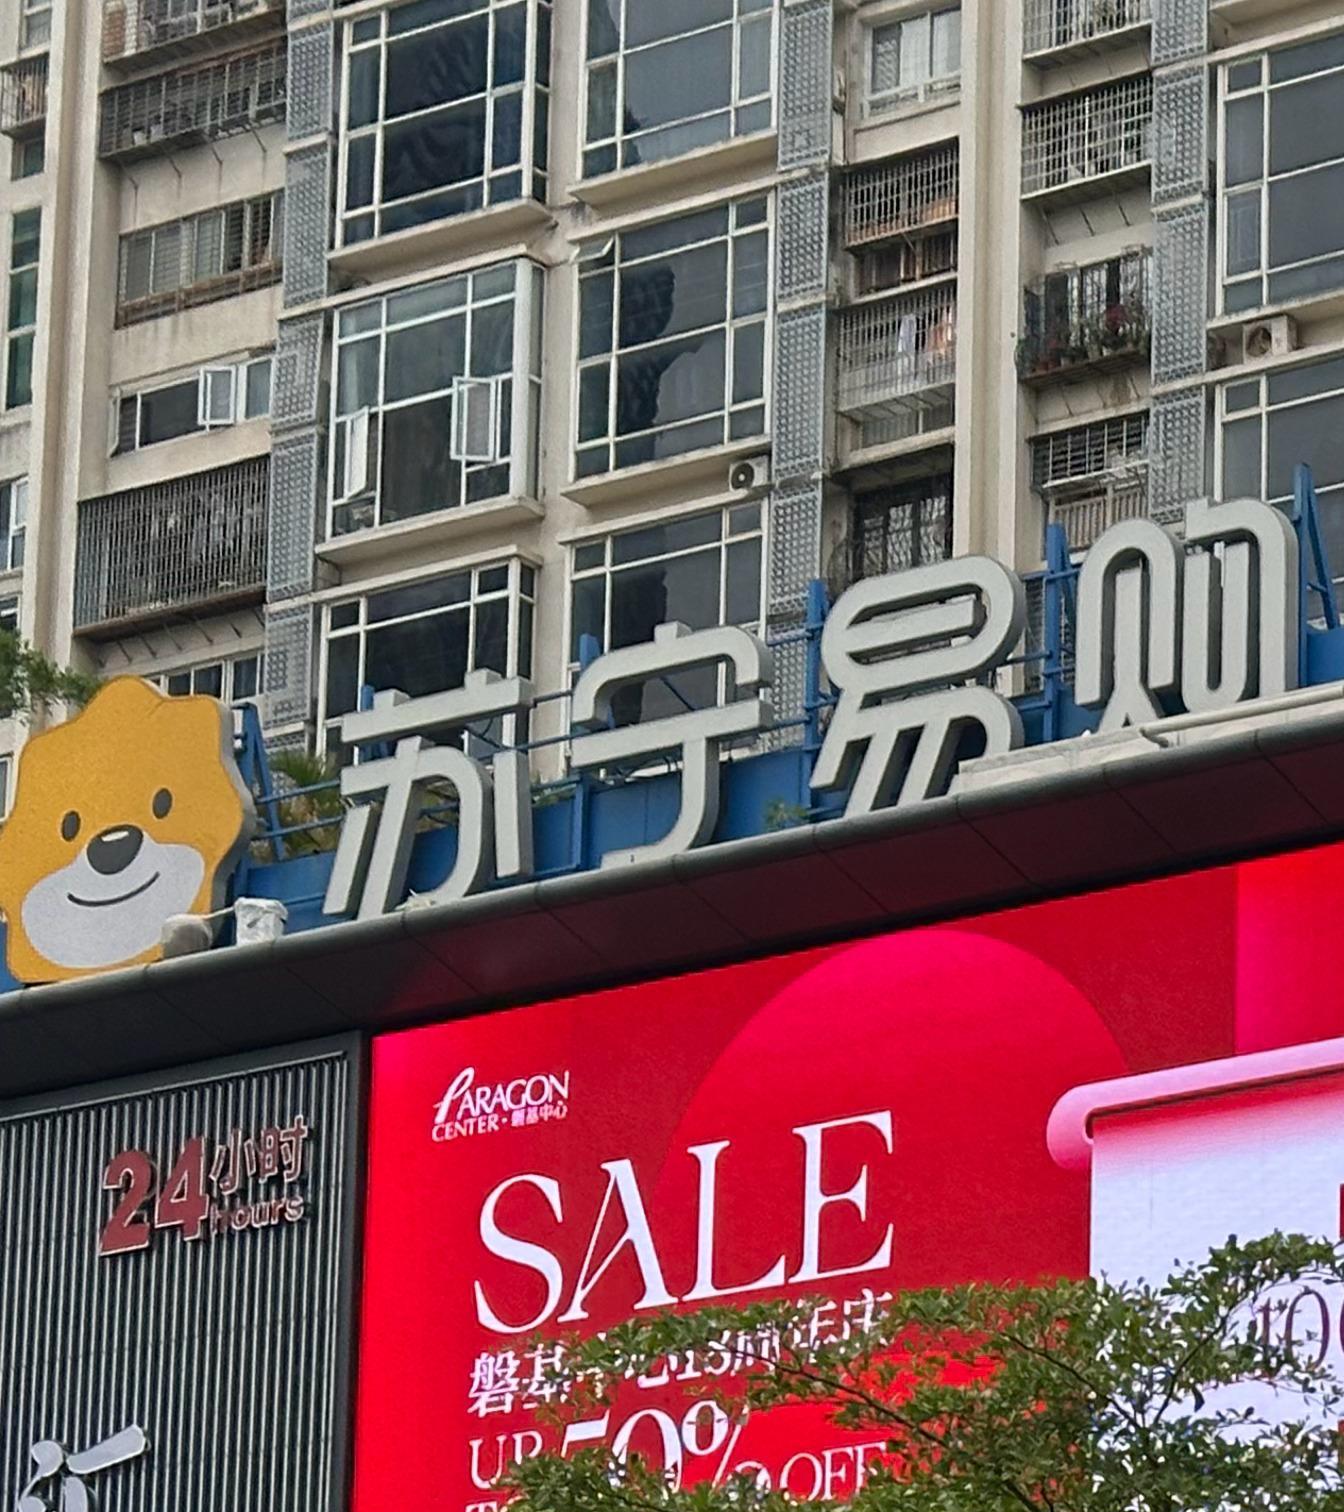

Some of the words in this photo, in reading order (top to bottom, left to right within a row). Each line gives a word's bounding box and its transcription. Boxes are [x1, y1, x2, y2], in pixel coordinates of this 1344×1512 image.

[324, 497, 1300, 920] 苏宁易购
[432, 1066, 570, 1125] PARAGON
[473, 1110, 894, 1334] SALE
